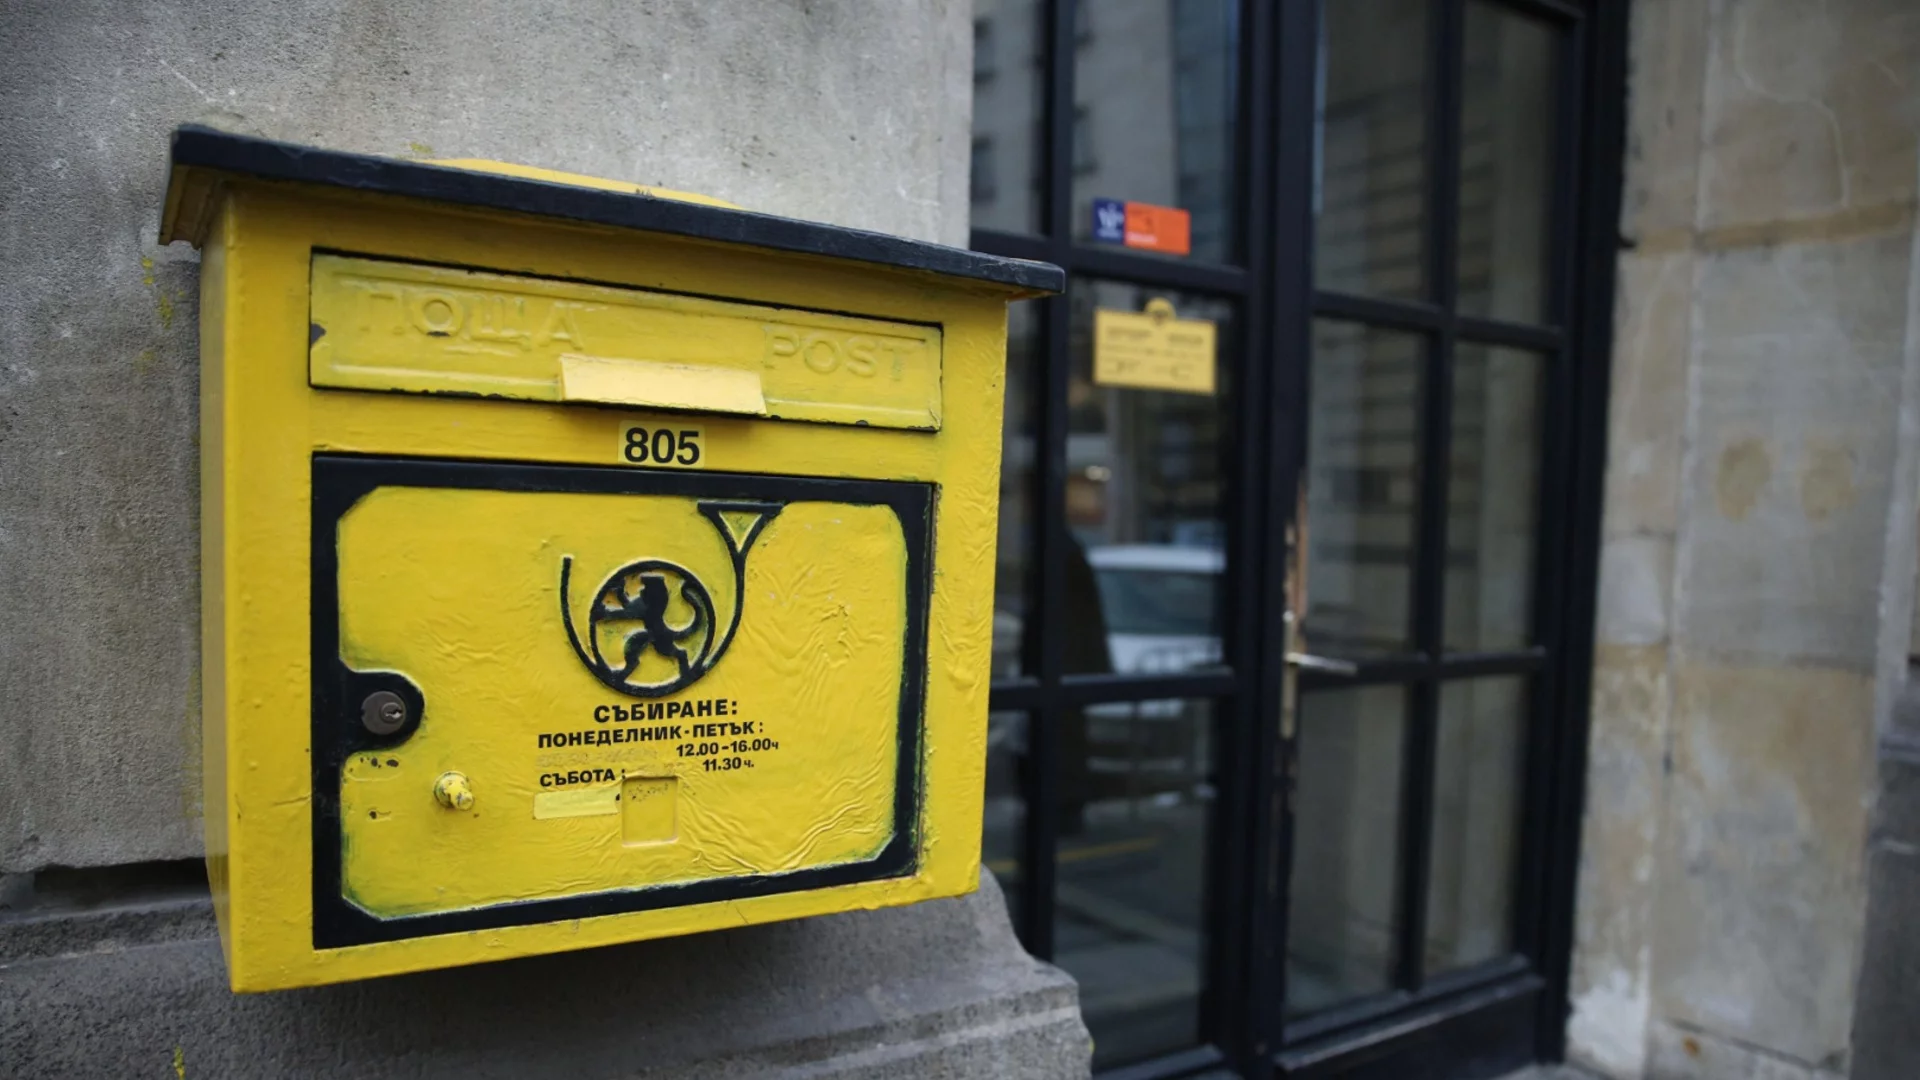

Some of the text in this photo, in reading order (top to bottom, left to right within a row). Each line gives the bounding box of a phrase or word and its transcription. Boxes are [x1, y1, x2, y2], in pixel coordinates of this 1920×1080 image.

[763, 325, 926, 382] POST
[624, 427, 700, 465] 805
[593, 699, 738, 723] СЪБИРАНЕ:
